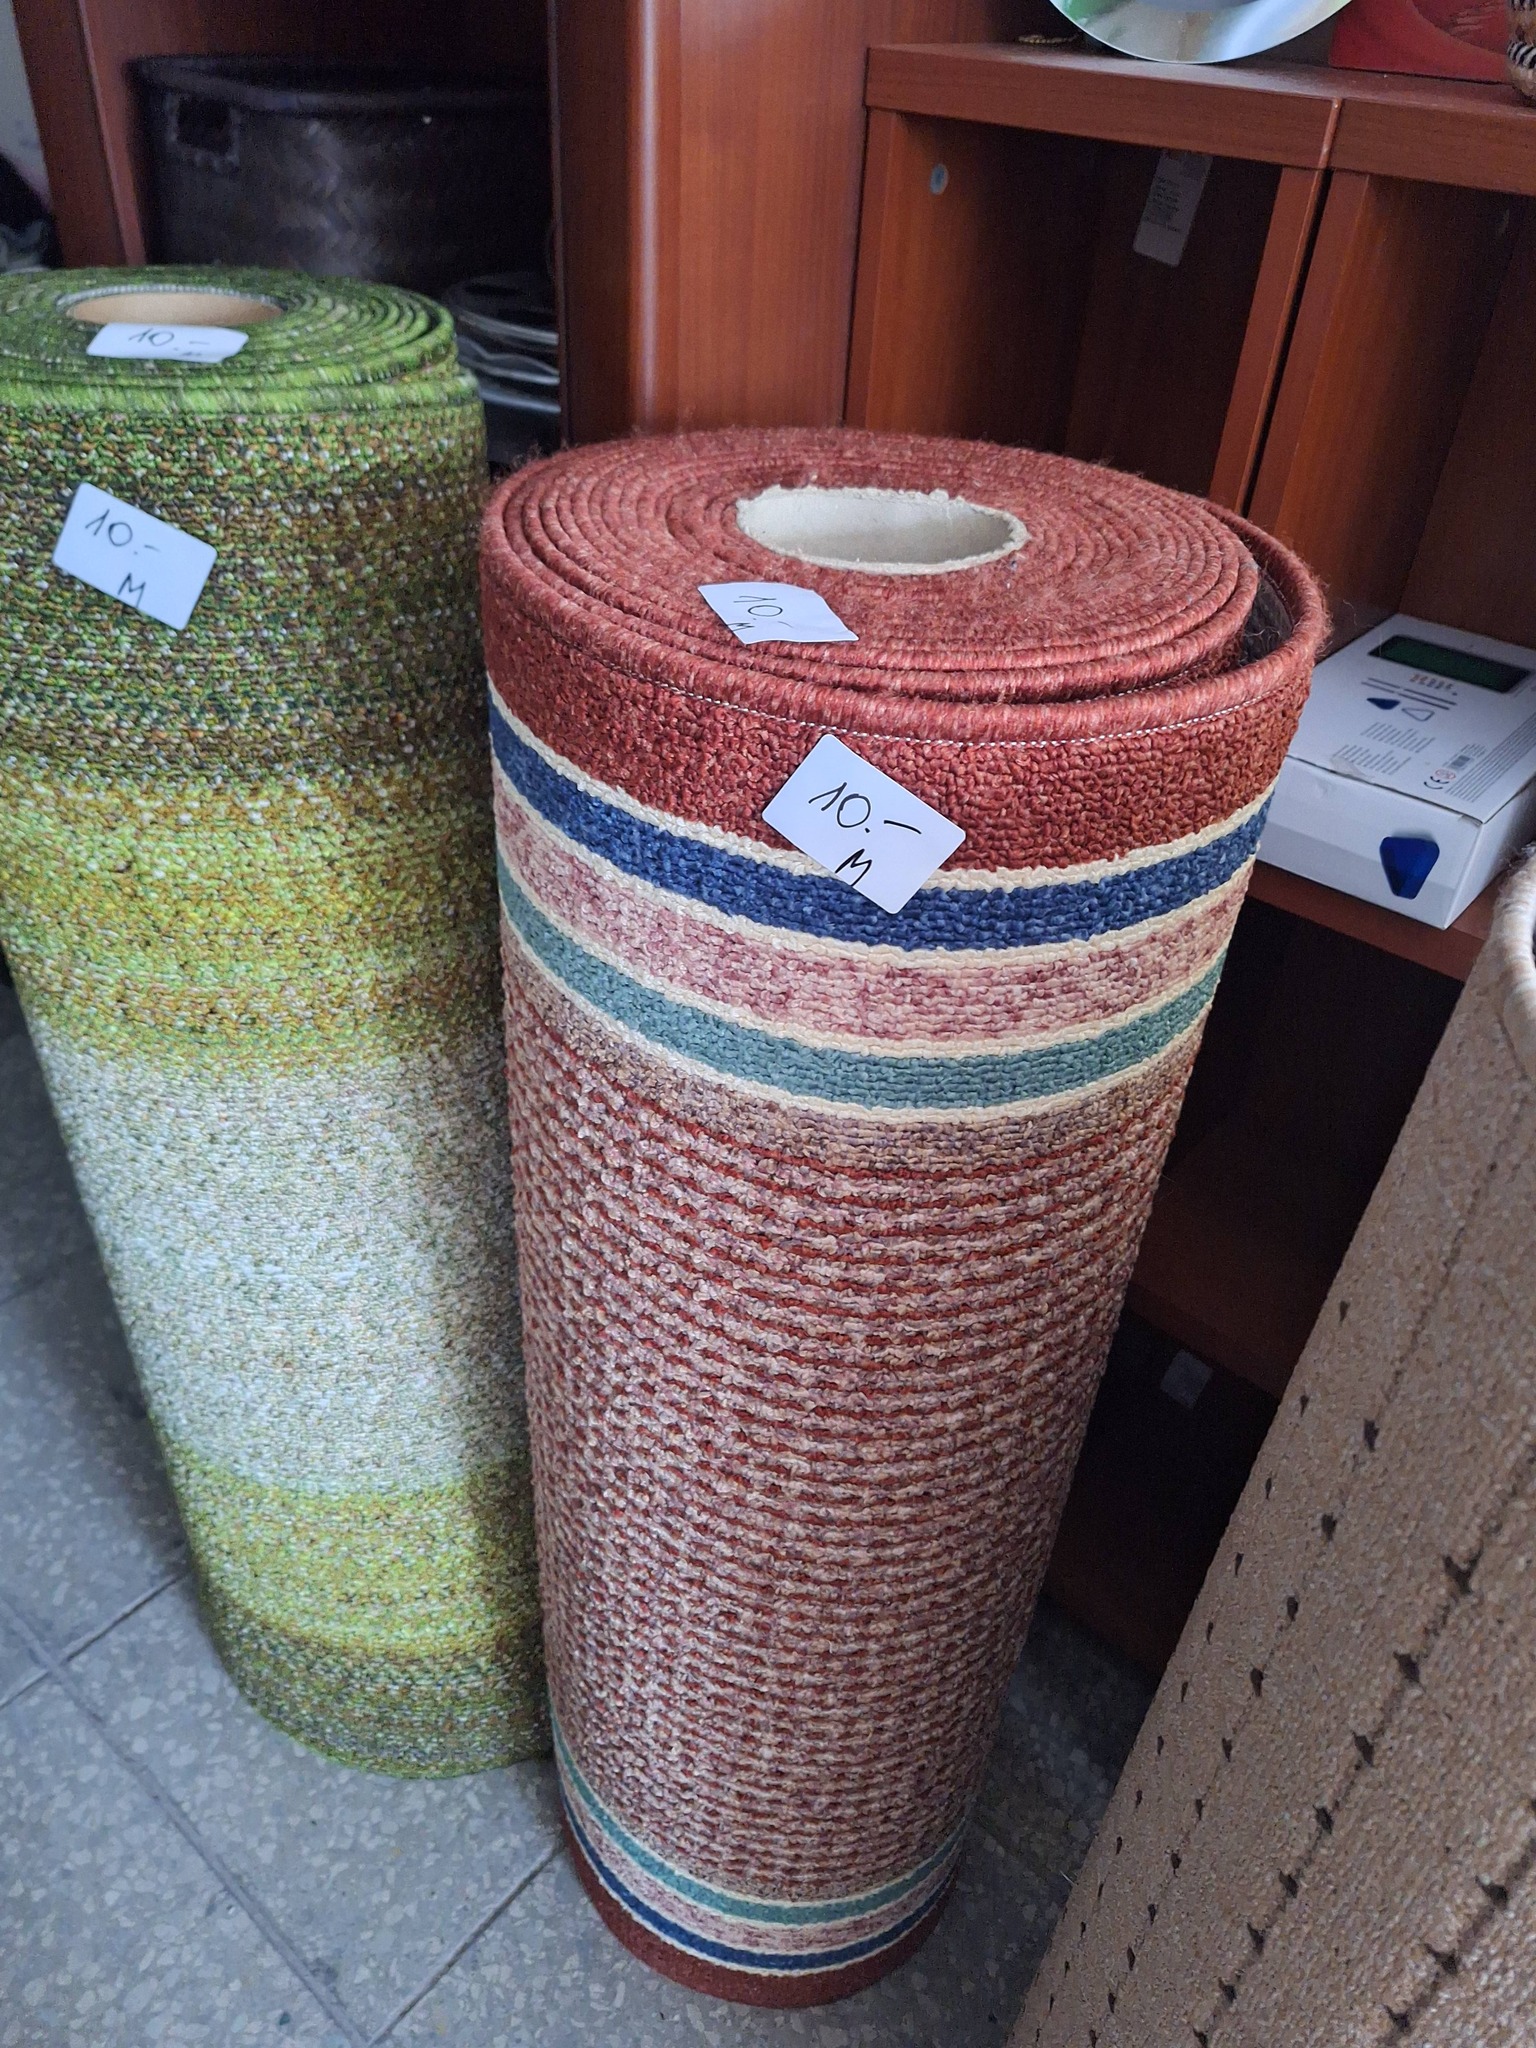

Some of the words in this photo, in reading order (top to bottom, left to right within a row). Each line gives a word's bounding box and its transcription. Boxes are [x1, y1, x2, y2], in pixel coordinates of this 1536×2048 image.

[117, 572, 147, 609] M
[807, 781, 923, 835] 10.-
[834, 848, 873, 887] M
